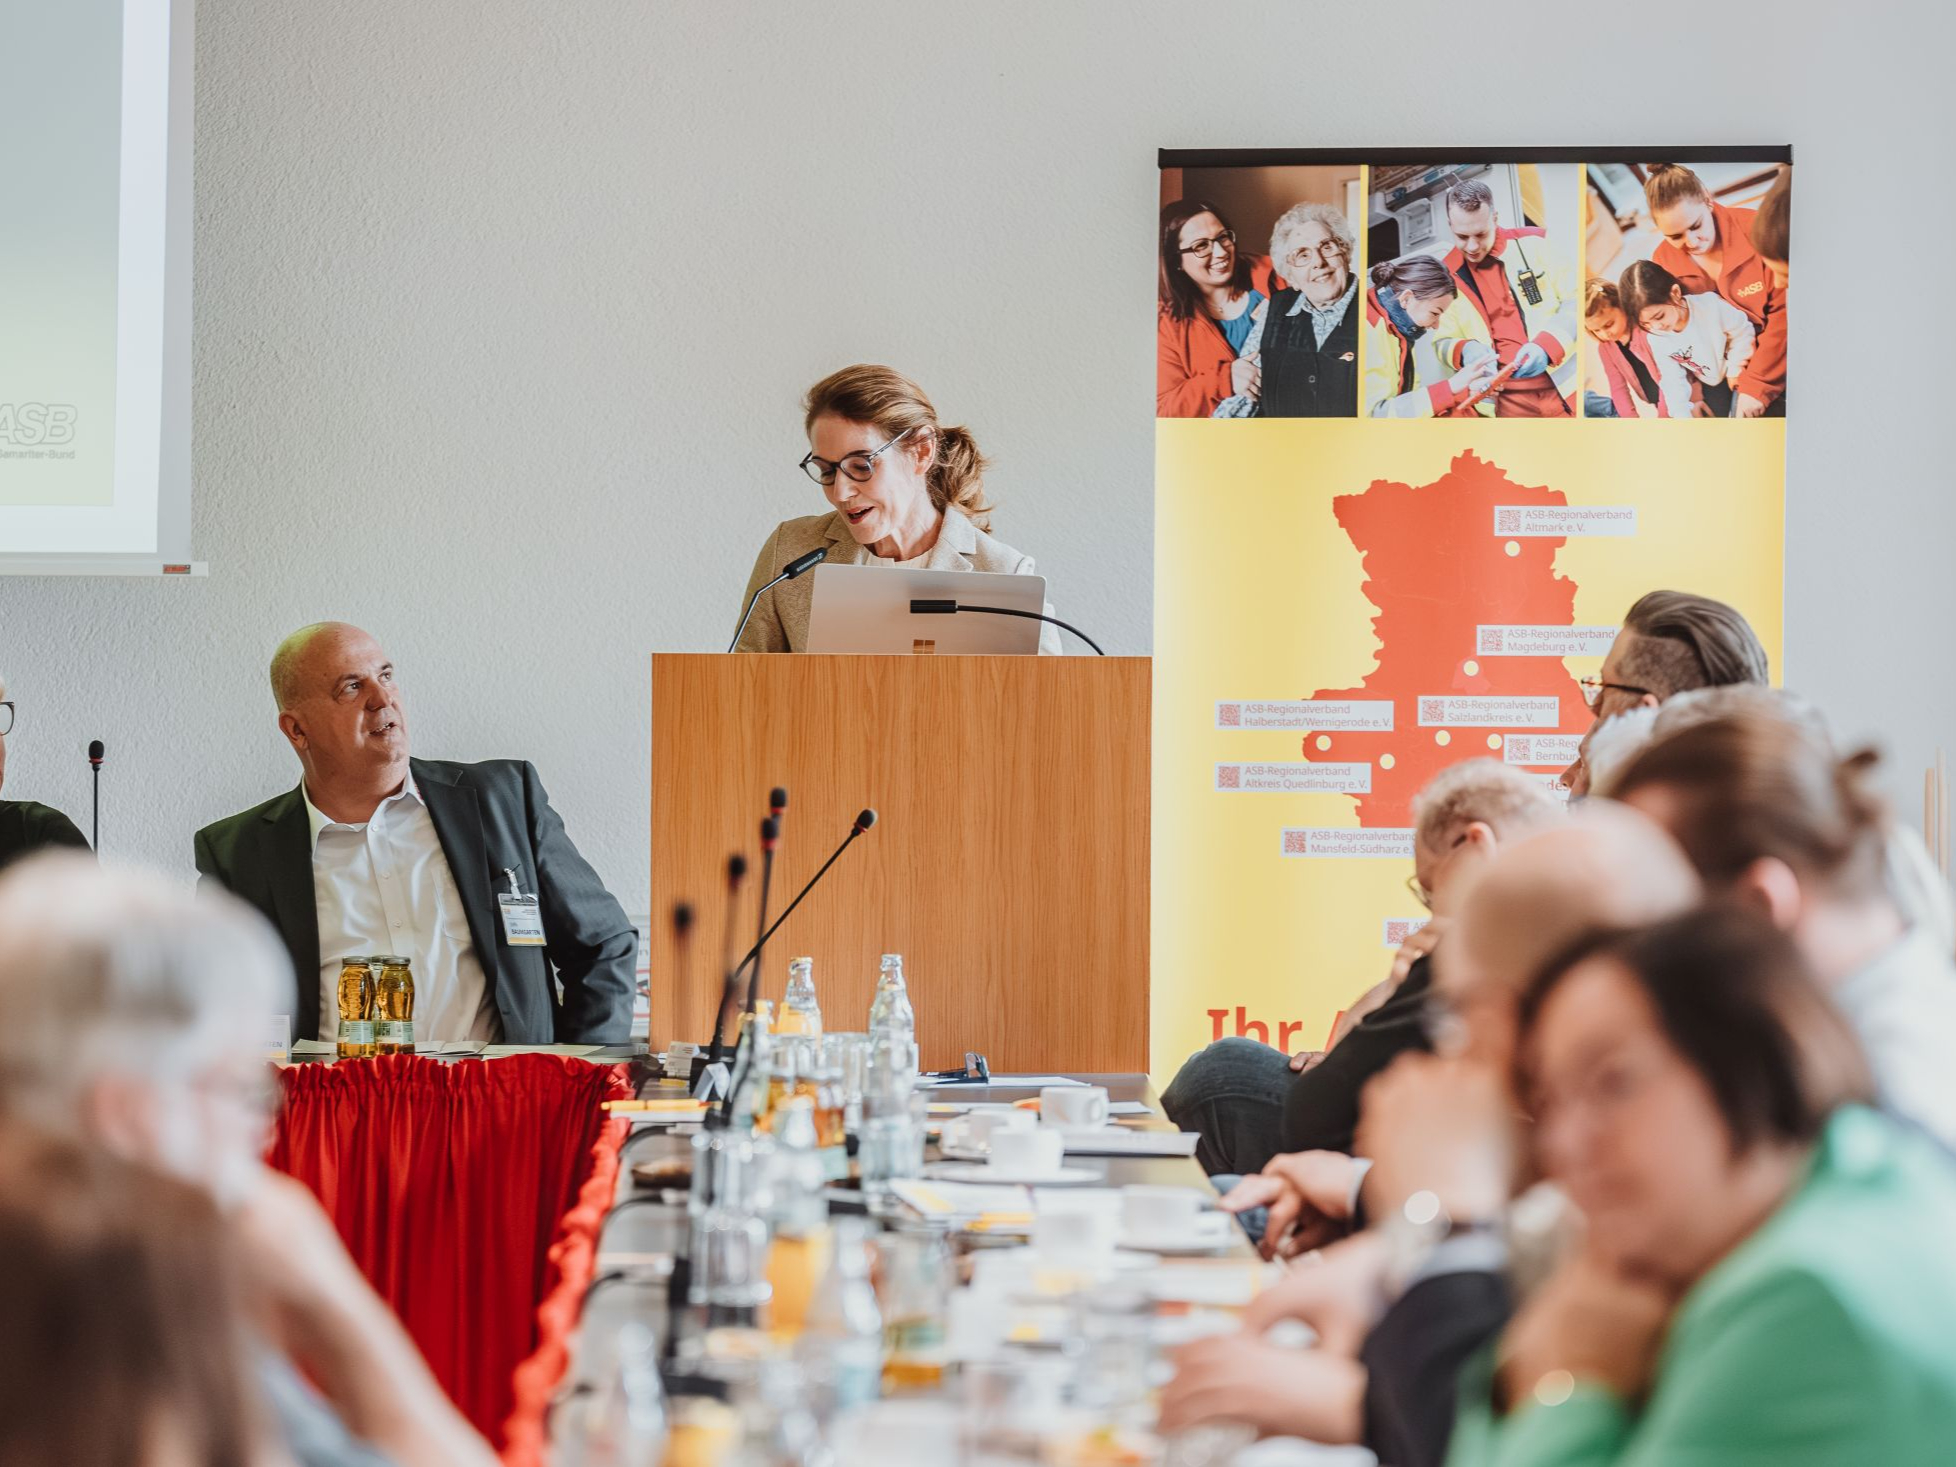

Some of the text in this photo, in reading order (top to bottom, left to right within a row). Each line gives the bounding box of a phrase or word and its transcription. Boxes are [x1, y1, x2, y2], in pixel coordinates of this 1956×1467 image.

[1743, 281, 1763, 296] ASB
[0, 402, 78, 446] ASB
[1525, 510, 1633, 521] ASB-Regionalverband
[1525, 523, 1564, 533] Altmark
[1507, 629, 1615, 641] ASB-Regionalverband
[1508, 642, 1566, 654] Magdeburg
[1244, 704, 1351, 716] ASB-Regionalverband
[1448, 700, 1556, 712] ASB-Regionalverband
[1244, 717, 1372, 729] Halberstadt/Wernigerode
[1448, 712, 1513, 723] Salzlandkreis
[1535, 751, 1578, 761] Bernbur
[1244, 766, 1351, 778] ASB-Regionalverband
[1244, 779, 1281, 789] Altkreis
[1283, 779, 1345, 791] Quedlinburg
[1310, 844, 1400, 854] Mansfeld-Südharz
[1207, 1006, 1303, 1055] Ihr
